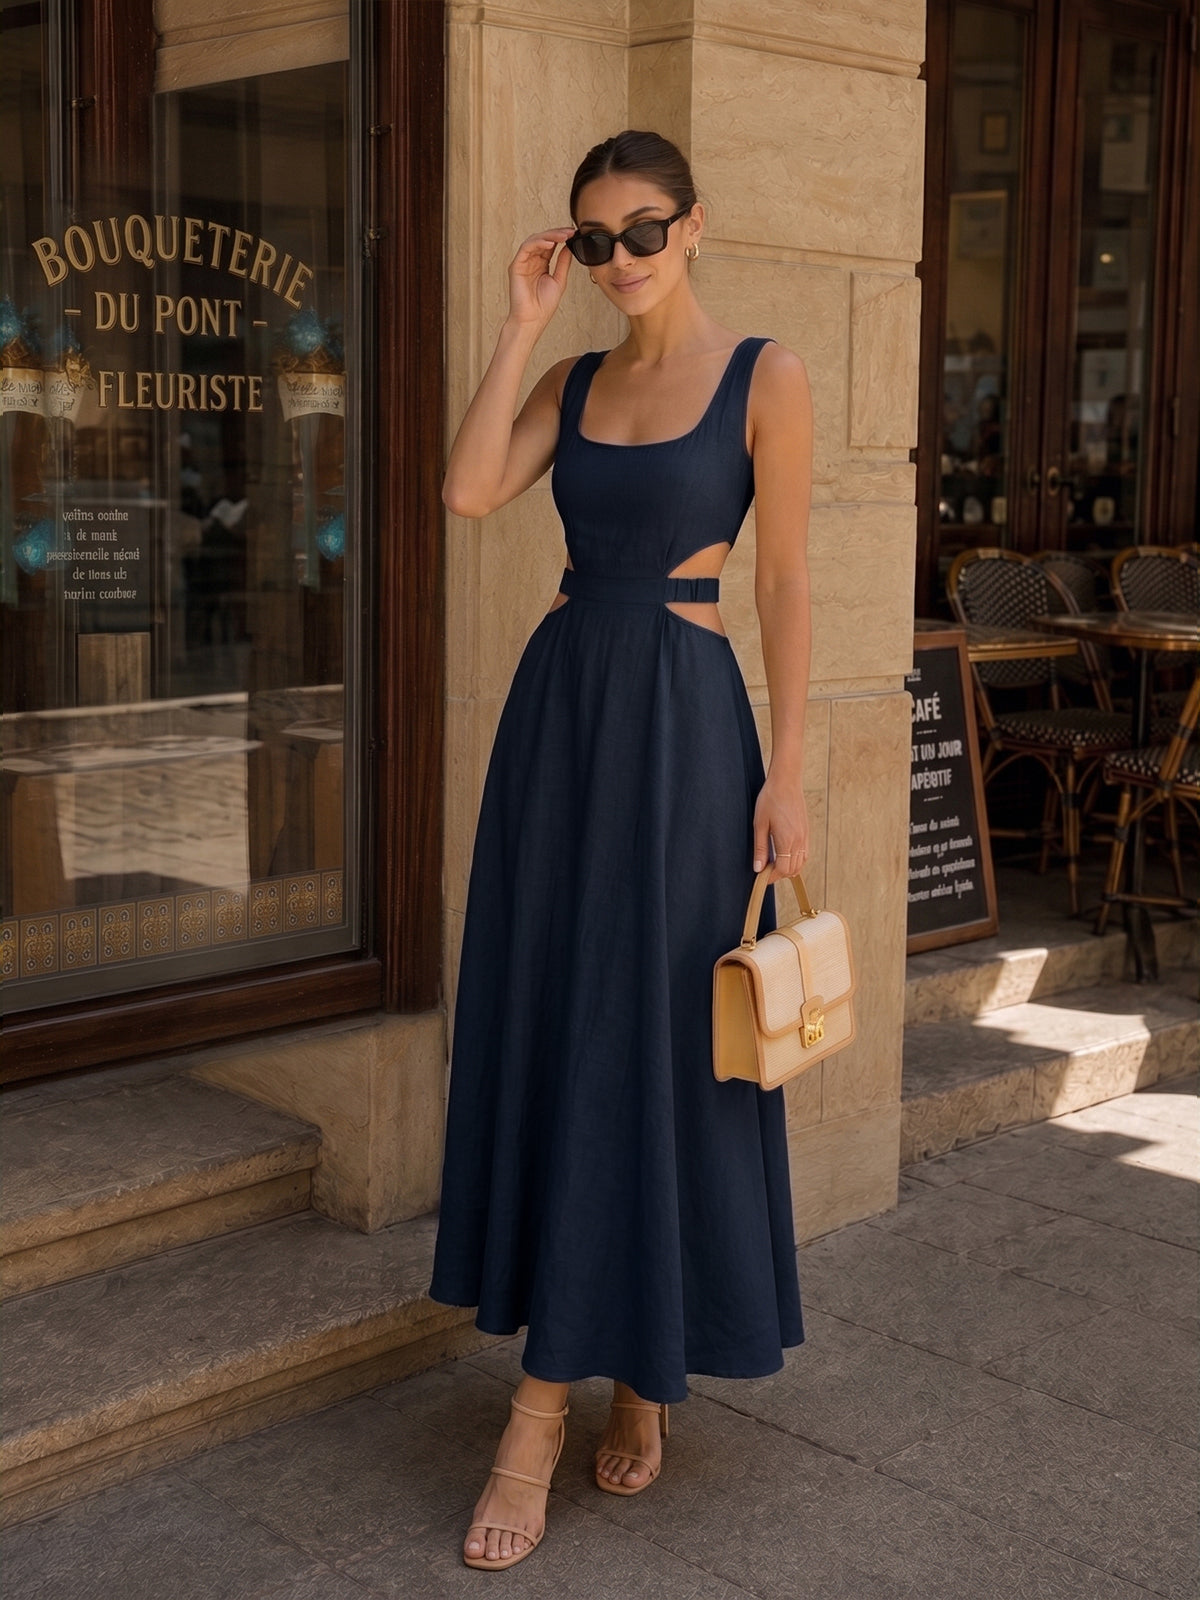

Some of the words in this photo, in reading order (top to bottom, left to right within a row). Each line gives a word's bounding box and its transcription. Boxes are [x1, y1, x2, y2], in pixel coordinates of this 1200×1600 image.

[31, 214, 314, 309] BOUQUETERIE
[94, 291, 140, 333] DU
[155, 294, 242, 337] PONT
[98, 370, 264, 413] FLEURISTE
[72, 566, 85, 580] de
